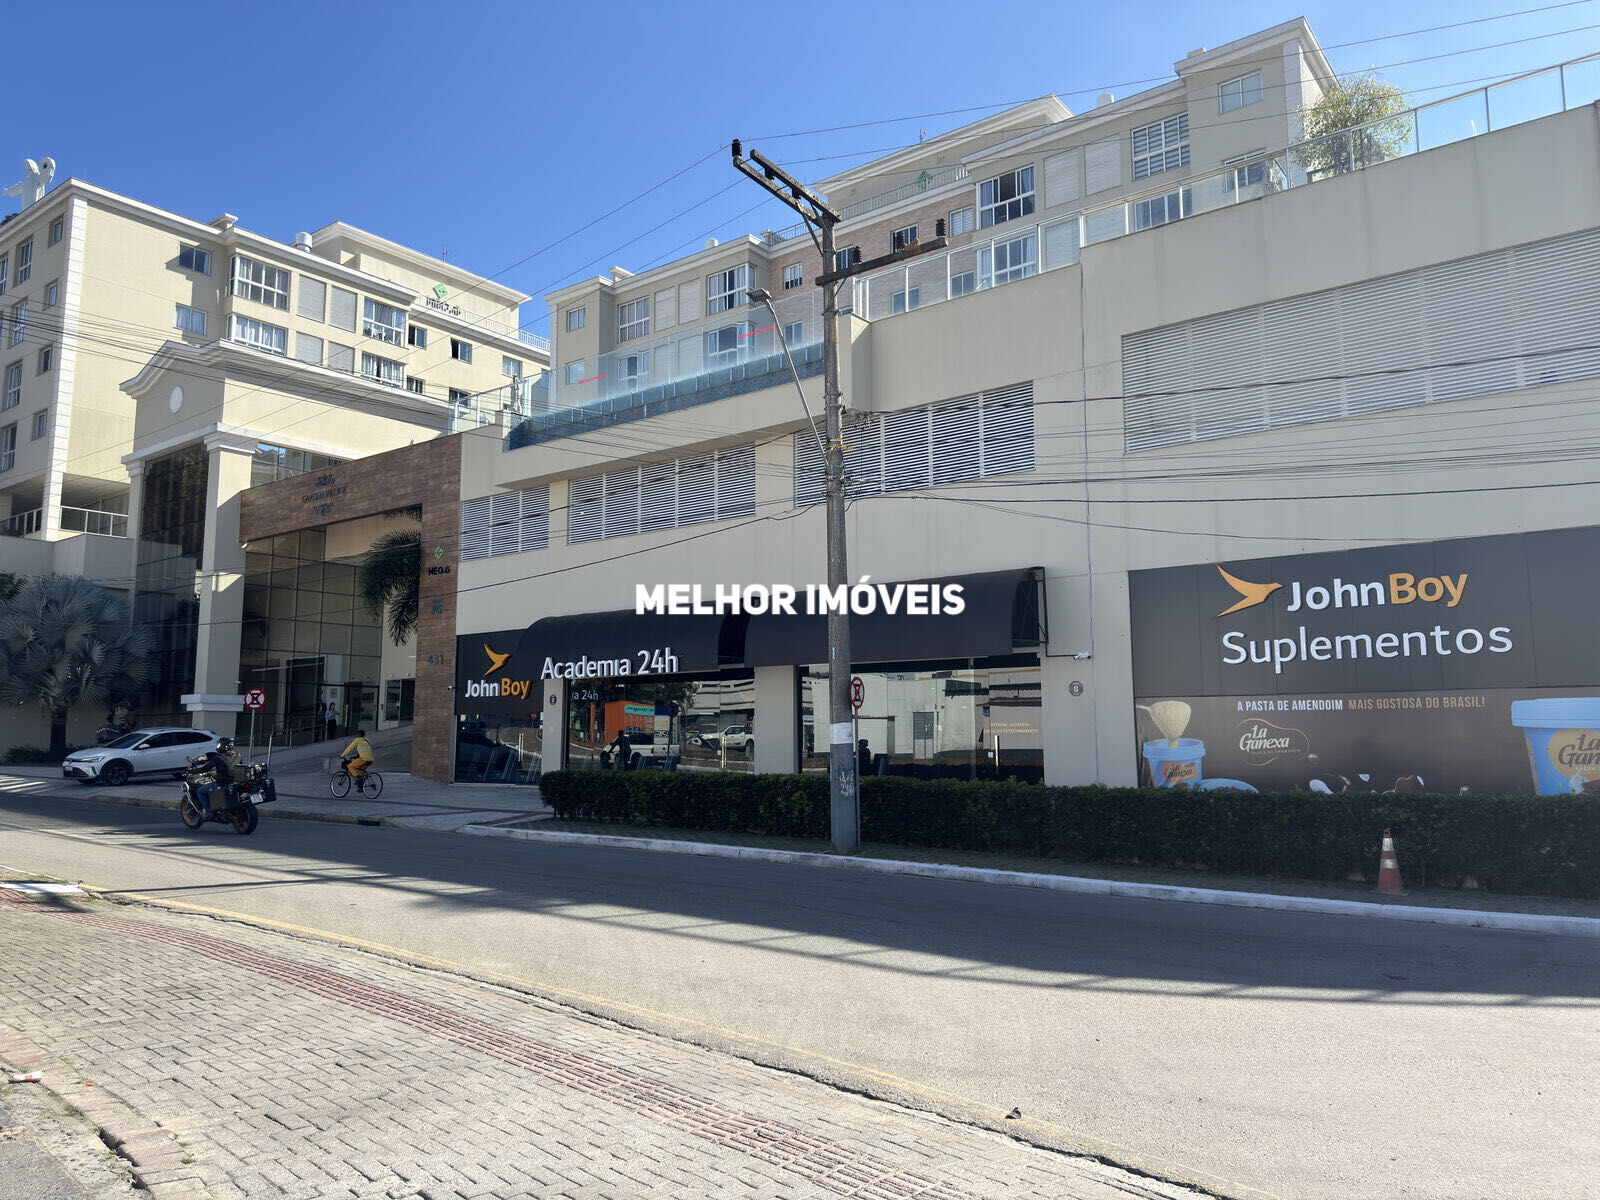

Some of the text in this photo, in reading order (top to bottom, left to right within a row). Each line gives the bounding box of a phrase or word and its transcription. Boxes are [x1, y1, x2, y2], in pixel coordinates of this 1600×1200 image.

[1222, 625, 1513, 675] Suplementos
[541, 647, 680, 680] Academia 24h
[1237, 696, 1485, 712] A PASTA DE AMENDOIM MAIS GOSTOSA DO BRASIL!
[1252, 725, 1267, 739] La
[1239, 733, 1290, 752] Ganexa
[1576, 734, 1600, 751] La
